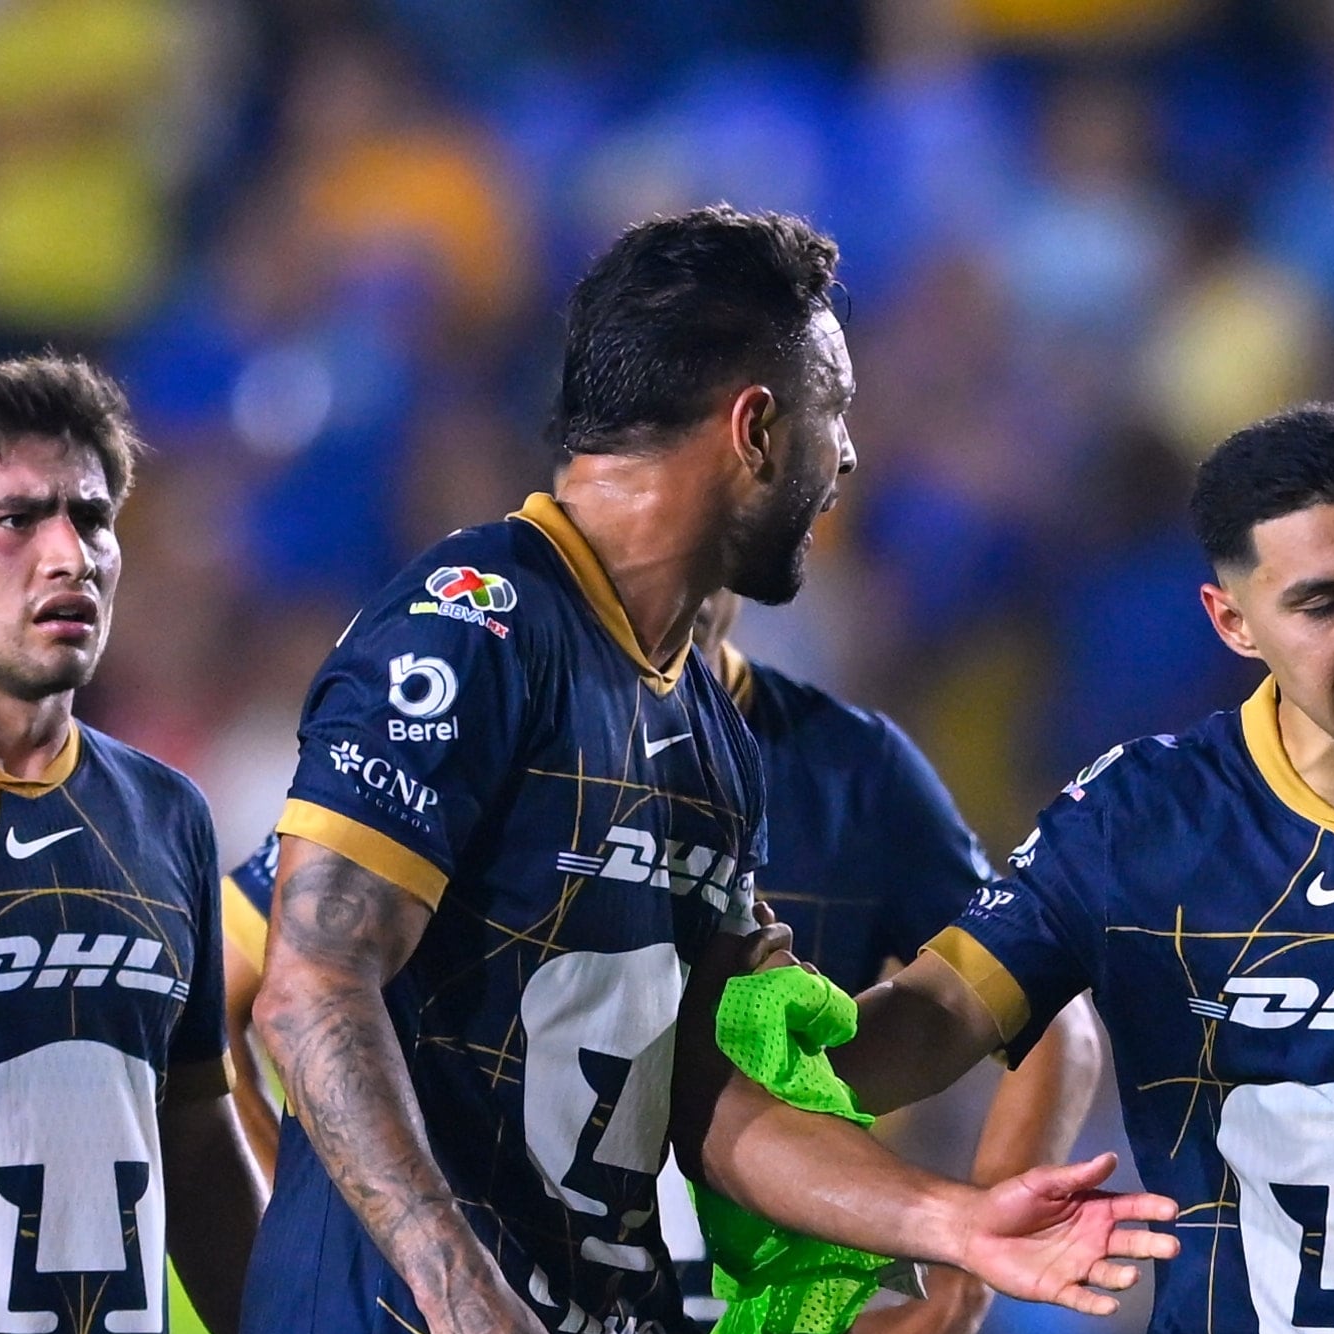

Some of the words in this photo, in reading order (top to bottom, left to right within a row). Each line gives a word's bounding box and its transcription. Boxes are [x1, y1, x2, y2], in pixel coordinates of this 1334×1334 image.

[438, 602, 485, 627] BBVA
[485, 616, 509, 639] MX
[388, 716, 459, 742] Berel
[362, 757, 438, 815] GNP
